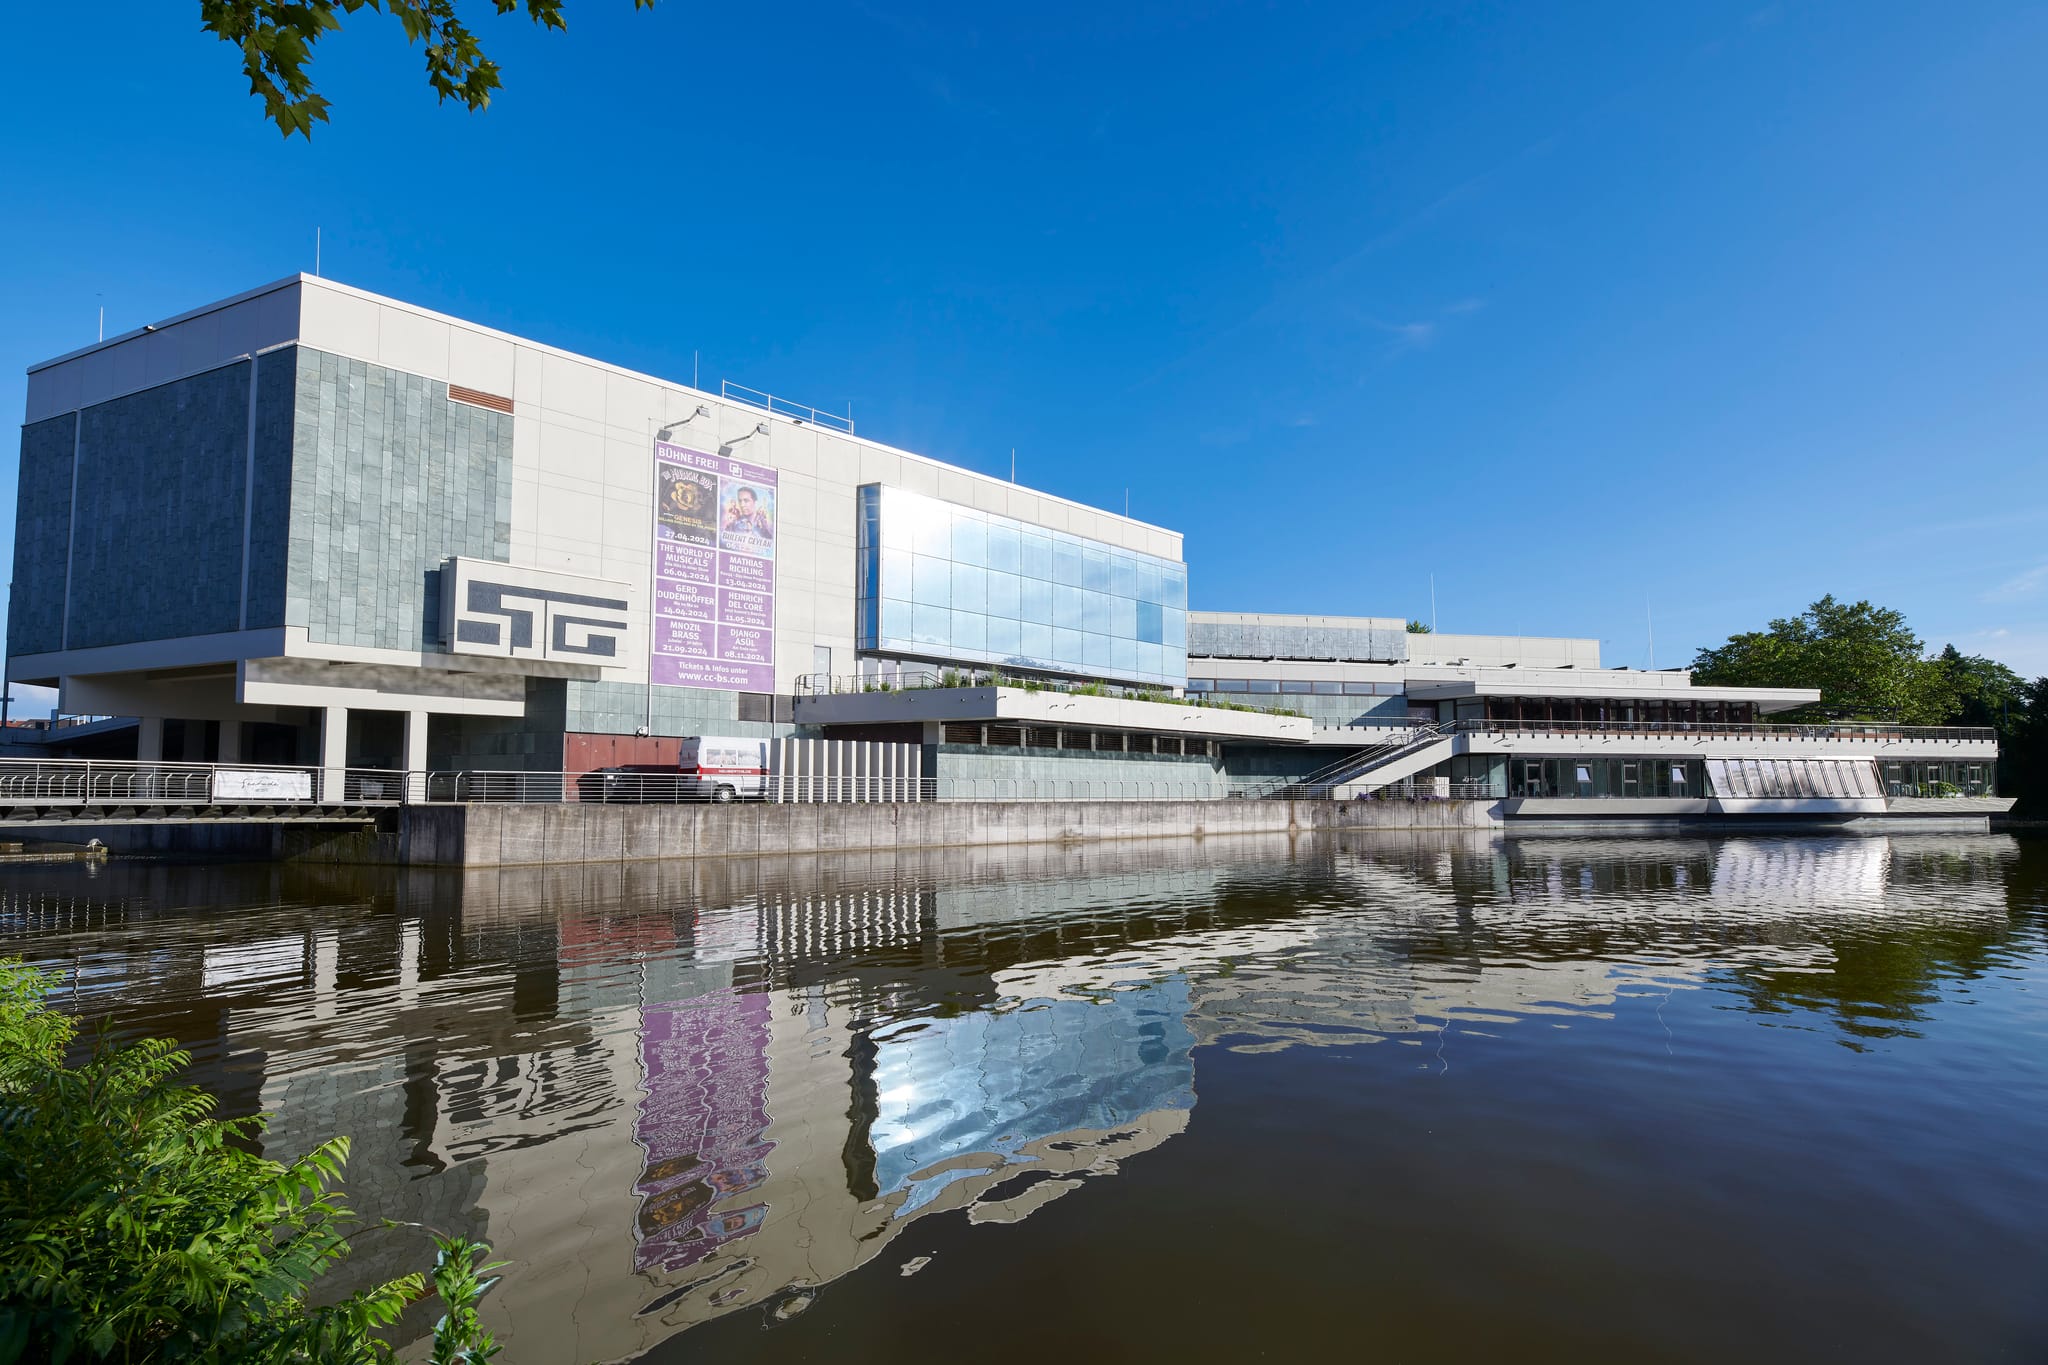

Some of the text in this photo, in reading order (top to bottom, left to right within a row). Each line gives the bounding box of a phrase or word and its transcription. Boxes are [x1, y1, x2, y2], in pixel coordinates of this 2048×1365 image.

[658, 447, 719, 470] BÜHNE FREI!
[665, 531, 710, 545] 27.04.2024
[660, 543, 715, 560] THE WORLD OF
[665, 553, 709, 567] MUSICALS
[729, 556, 764, 569] MATHIAS
[664, 567, 710, 582] 06.04.2024
[729, 564, 764, 577] RICHLING
[675, 584, 698, 594] GERD
[726, 578, 767, 591] 13.04.2024
[657, 590, 714, 605] DUDENHÖFFER
[728, 591, 763, 604] HEINRICH
[664, 606, 708, 619] 14.04.2024
[728, 600, 764, 612] DEL CORE
[670, 621, 702, 632] MNOZIL
[726, 615, 766, 626] 11.05.2024
[672, 630, 700, 640] BRASS
[730, 628, 760, 639] DJANGO
[735, 637, 756, 647] ASÜL
[662, 644, 707, 656] 21.09.2024
[724, 650, 765, 662] 08.11.2024
[678, 661, 748, 675] Tickets & Infos unter
[678, 671, 748, 685] www.cc-bs.com
